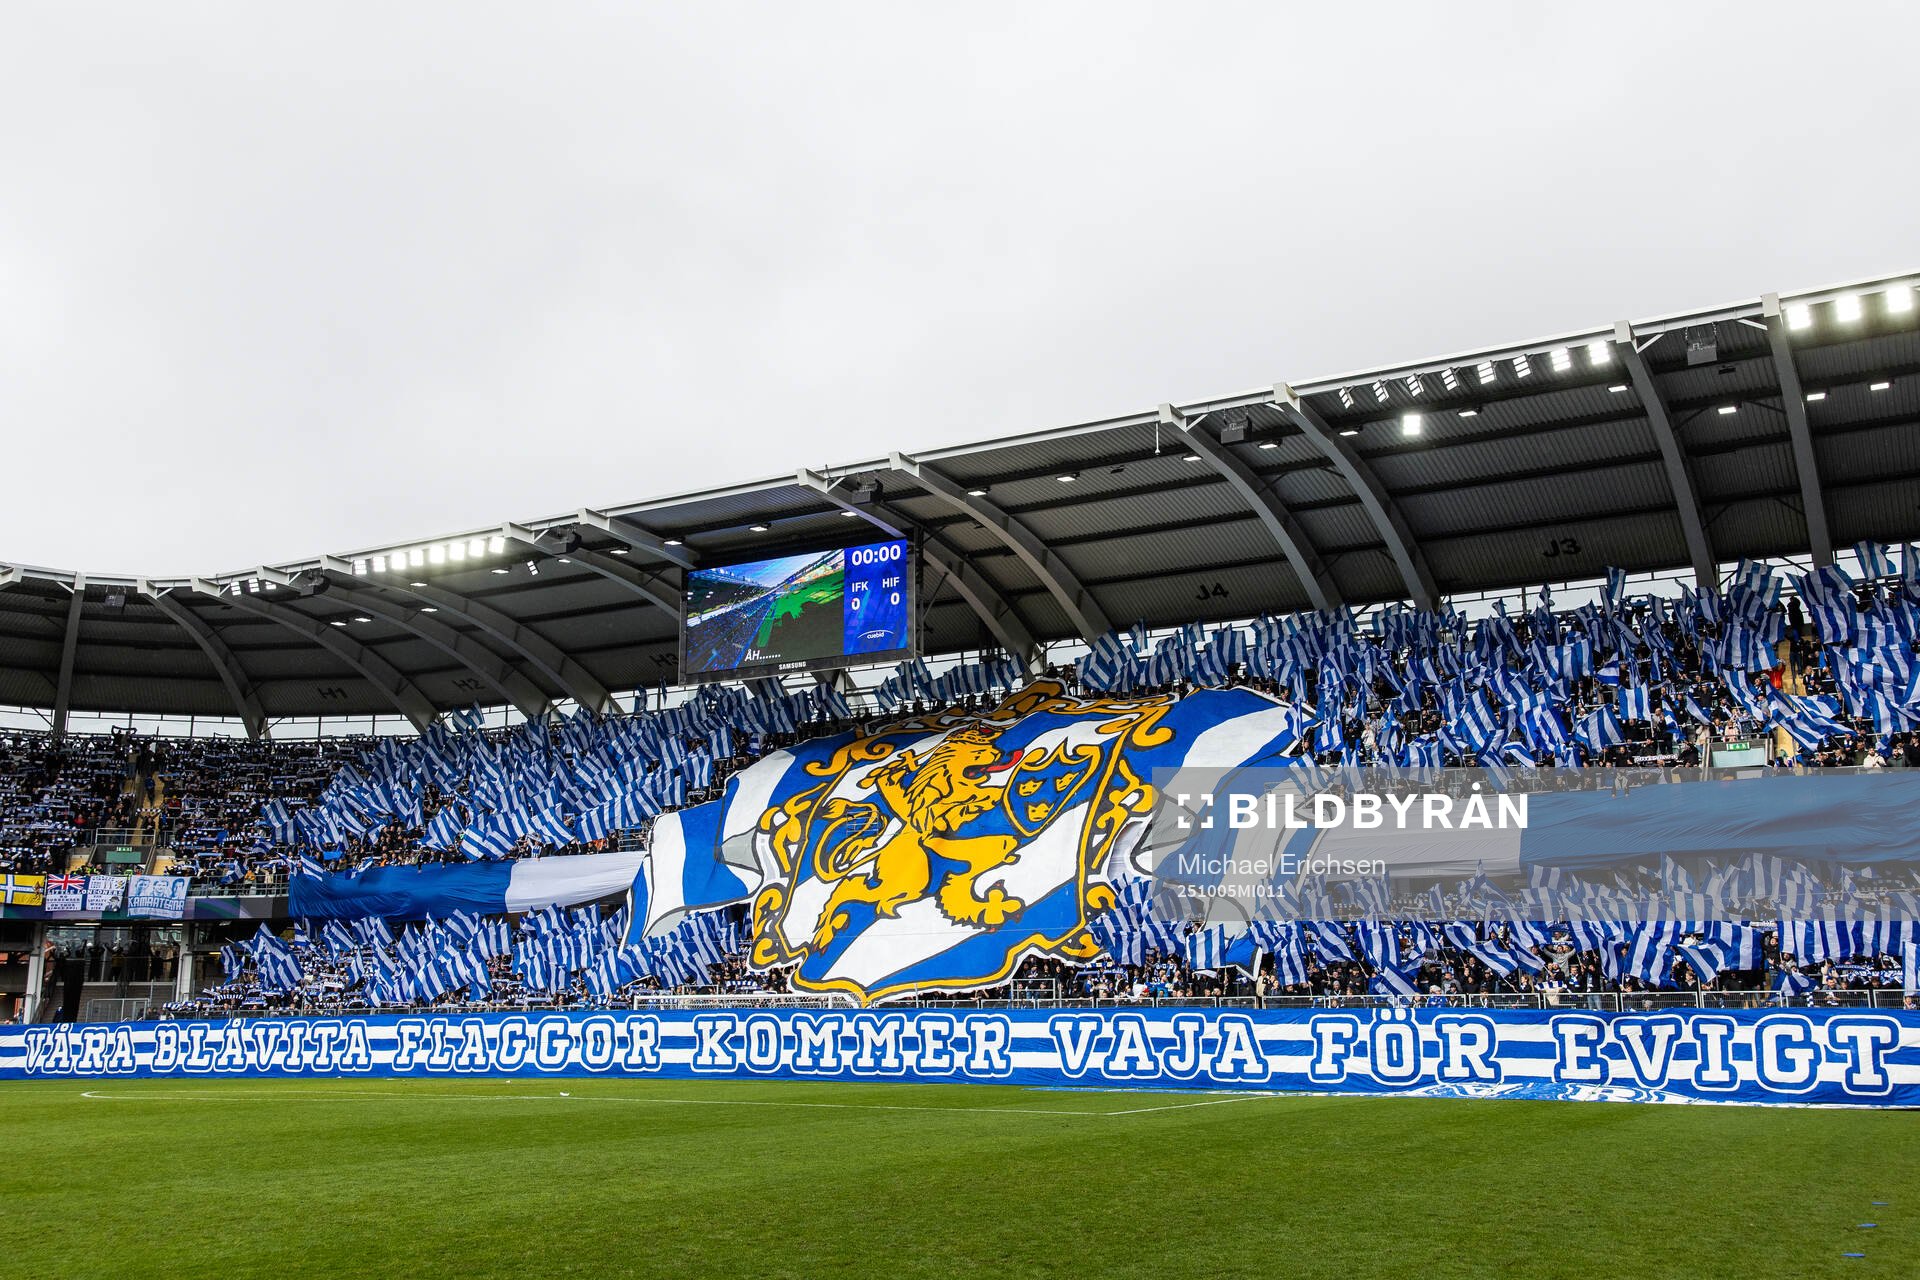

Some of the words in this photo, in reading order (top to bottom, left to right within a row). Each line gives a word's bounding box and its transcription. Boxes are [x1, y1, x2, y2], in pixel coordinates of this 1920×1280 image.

[851, 544, 901, 566] 00:00
[1543, 538, 1581, 557] J3
[851, 581, 869, 593] IFK
[882, 576, 900, 589] HIF
[1196, 582, 1229, 600] J4
[851, 597, 861, 611] 0
[890, 592, 900, 605] 0
[778, 661, 807, 670] SAMSUNG
[317, 687, 348, 699] H1
[452, 677, 486, 691] H2
[26, 1024, 135, 1070] VÅRA
[154, 1018, 371, 1071] BLÅVITA
[395, 1018, 661, 1070] FLAGGOR
[694, 1017, 1010, 1073] KOMMER
[1052, 1016, 1264, 1078] VAJA
[1314, 1009, 1501, 1081] FÖR
[1553, 1018, 1897, 1090] EVIGT
